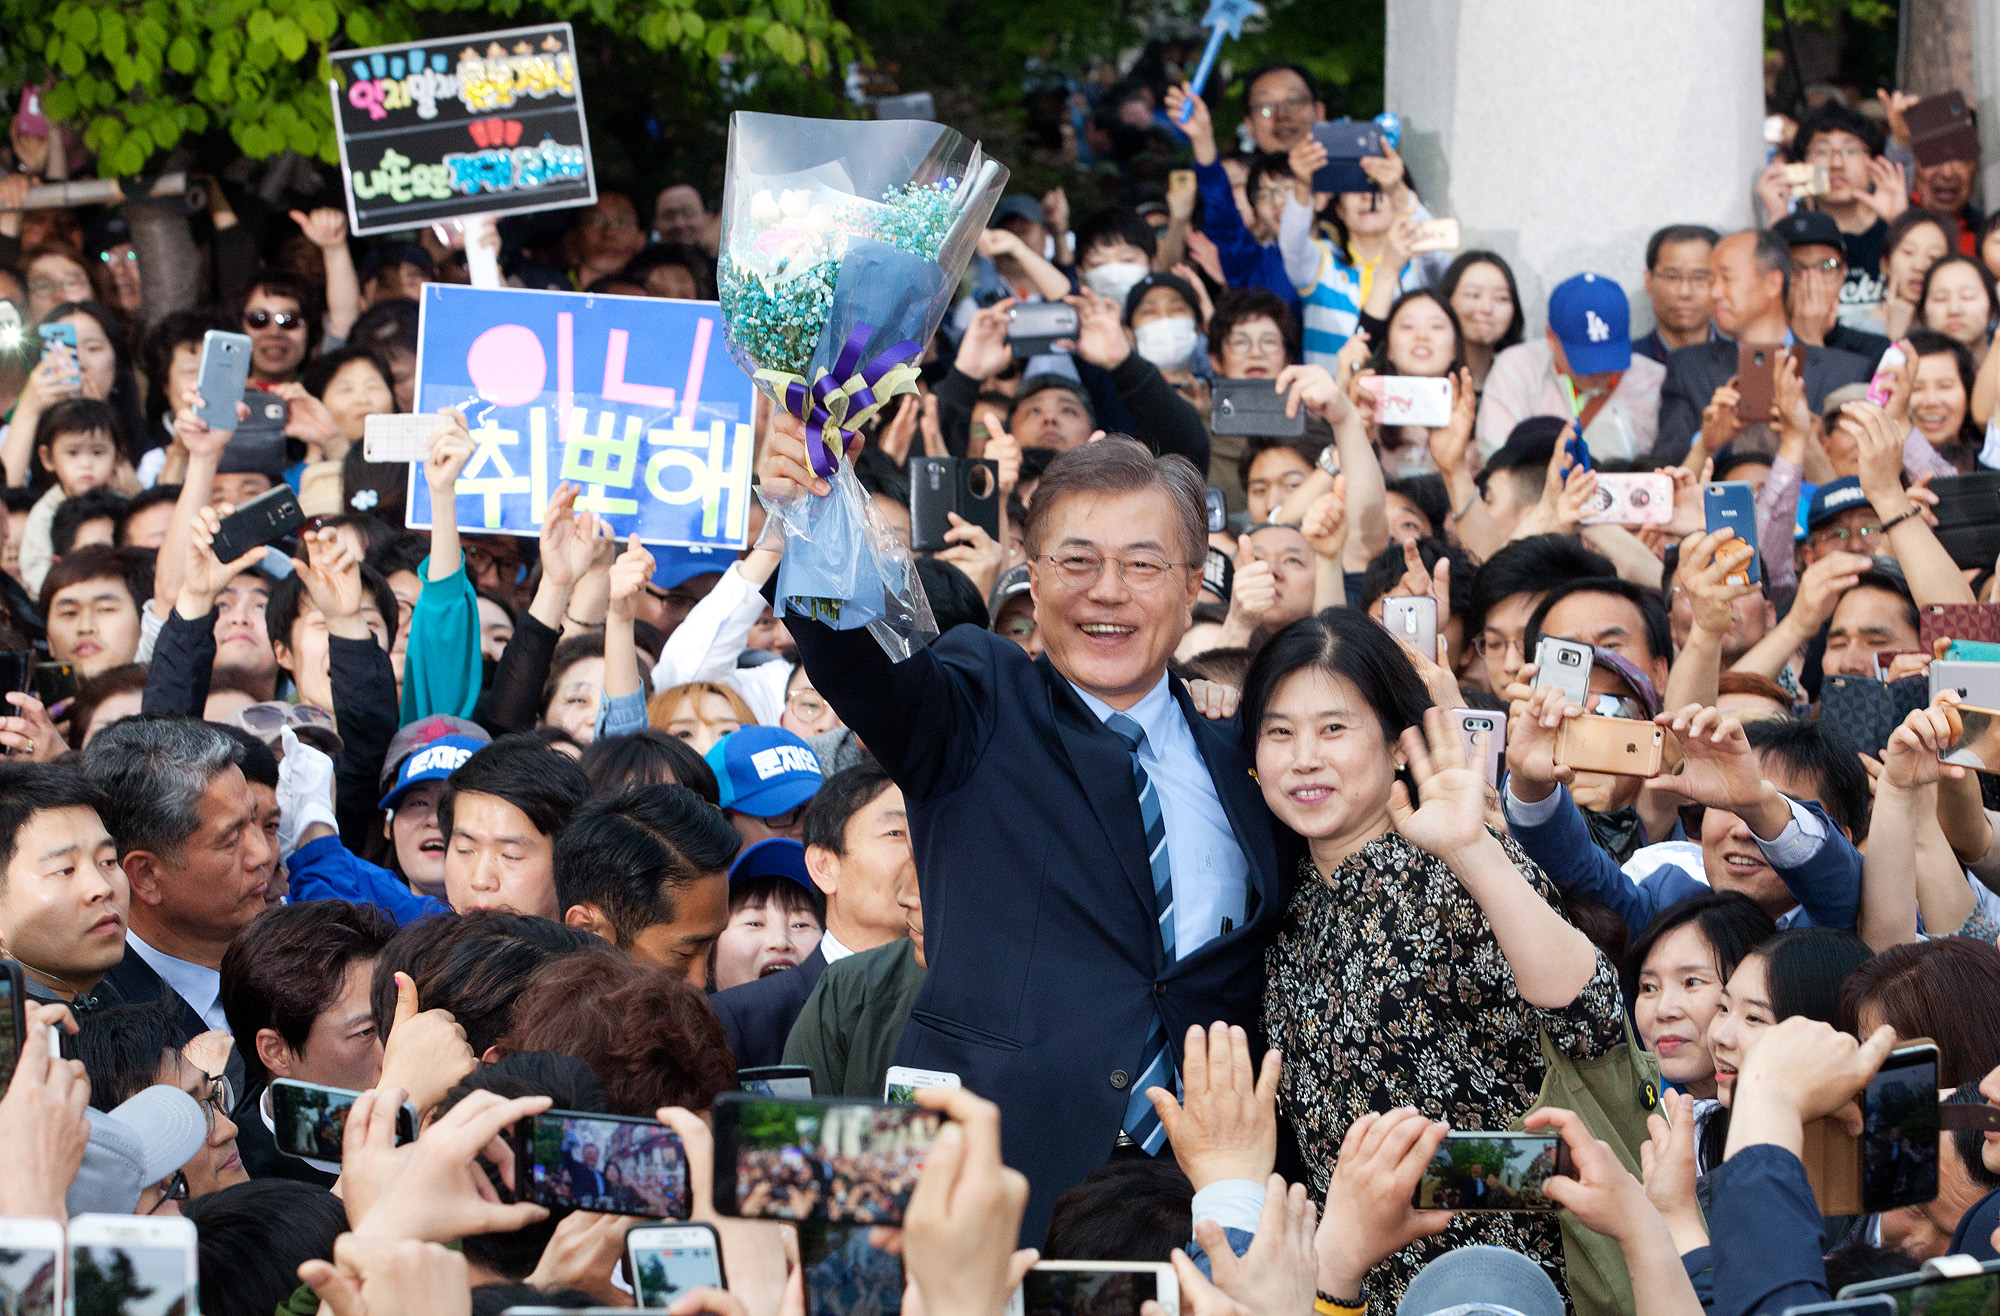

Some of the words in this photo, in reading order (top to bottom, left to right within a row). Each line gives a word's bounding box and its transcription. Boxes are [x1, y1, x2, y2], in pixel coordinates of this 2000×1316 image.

[352, 148, 452, 202] 내손으로
[1585, 310, 1609, 342] LA
[467, 312, 713, 442] 이니
[454, 406, 751, 540] 취뽀해
[750, 745, 822, 781] 문재인
